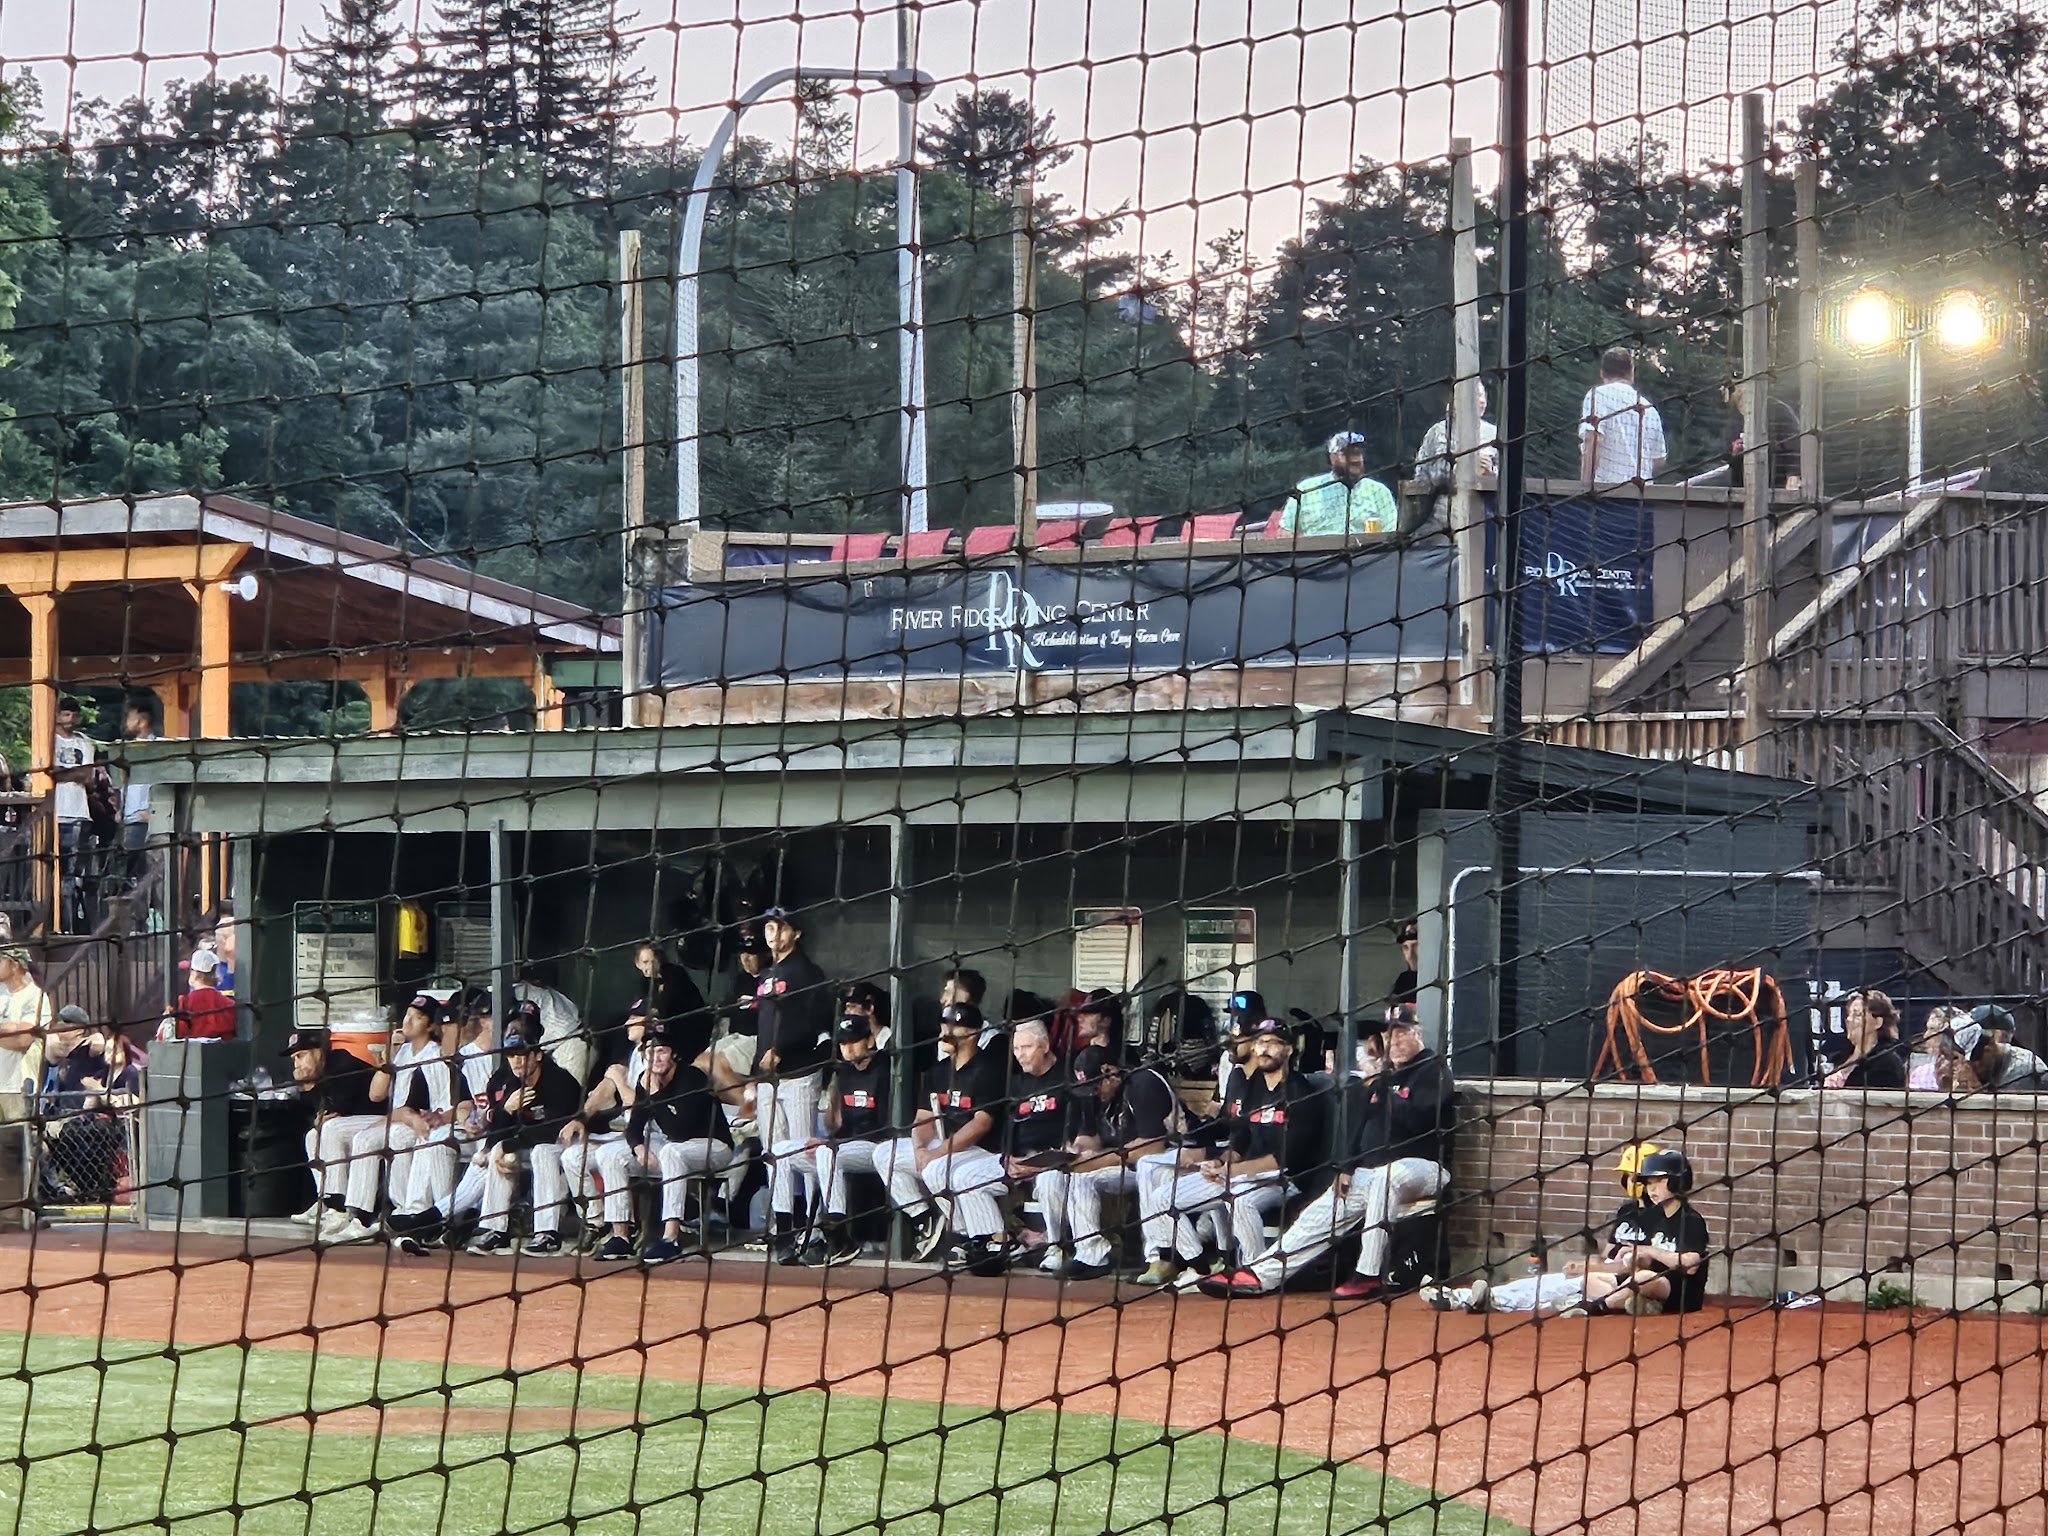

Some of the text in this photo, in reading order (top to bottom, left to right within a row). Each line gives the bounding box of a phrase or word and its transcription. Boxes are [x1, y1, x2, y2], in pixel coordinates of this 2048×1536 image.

[892, 607, 943, 630] RIVER
[1077, 600, 1150, 623] CENTER
[1031, 630, 1099, 646] Rehabiliation
